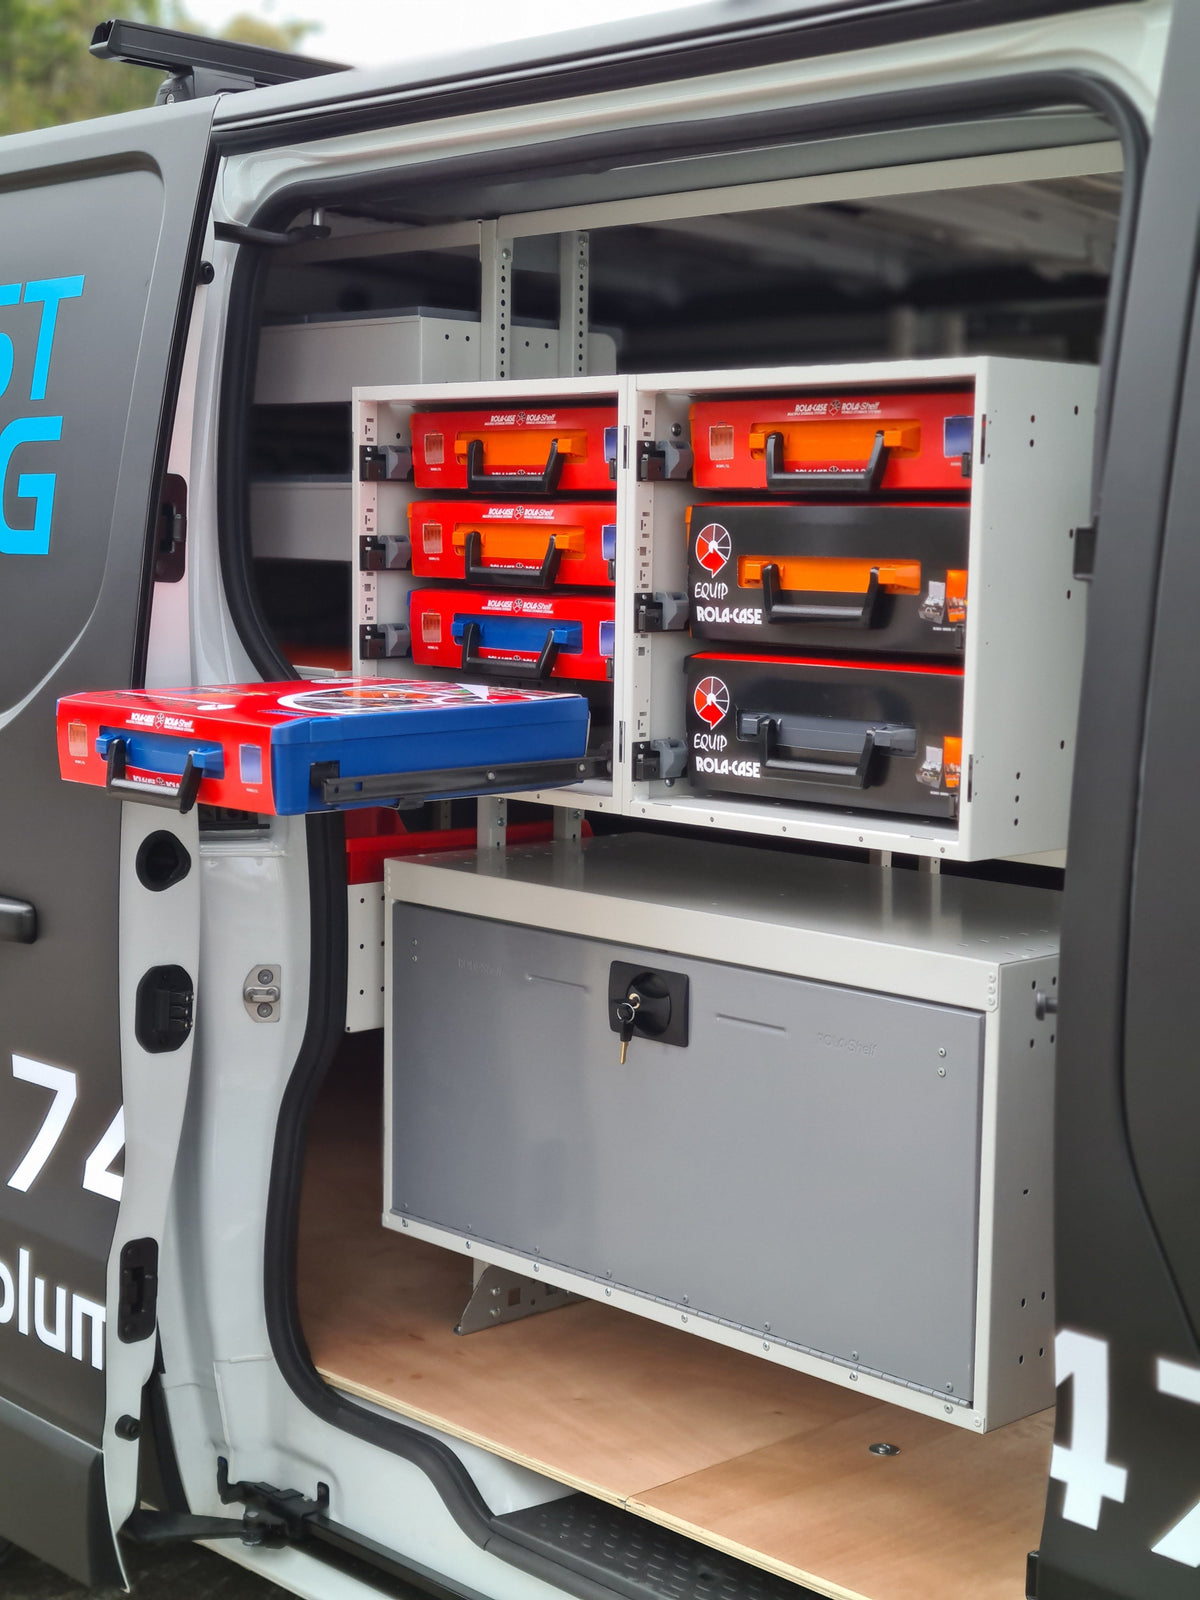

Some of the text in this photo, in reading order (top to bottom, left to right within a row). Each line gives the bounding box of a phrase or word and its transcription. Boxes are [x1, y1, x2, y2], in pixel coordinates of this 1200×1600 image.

[694, 581, 729, 601] EQUIP
[696, 605, 763, 625] ROLA-CASE
[693, 732, 728, 752] EQUIP
[695, 755, 761, 779] ROLA-CASE
